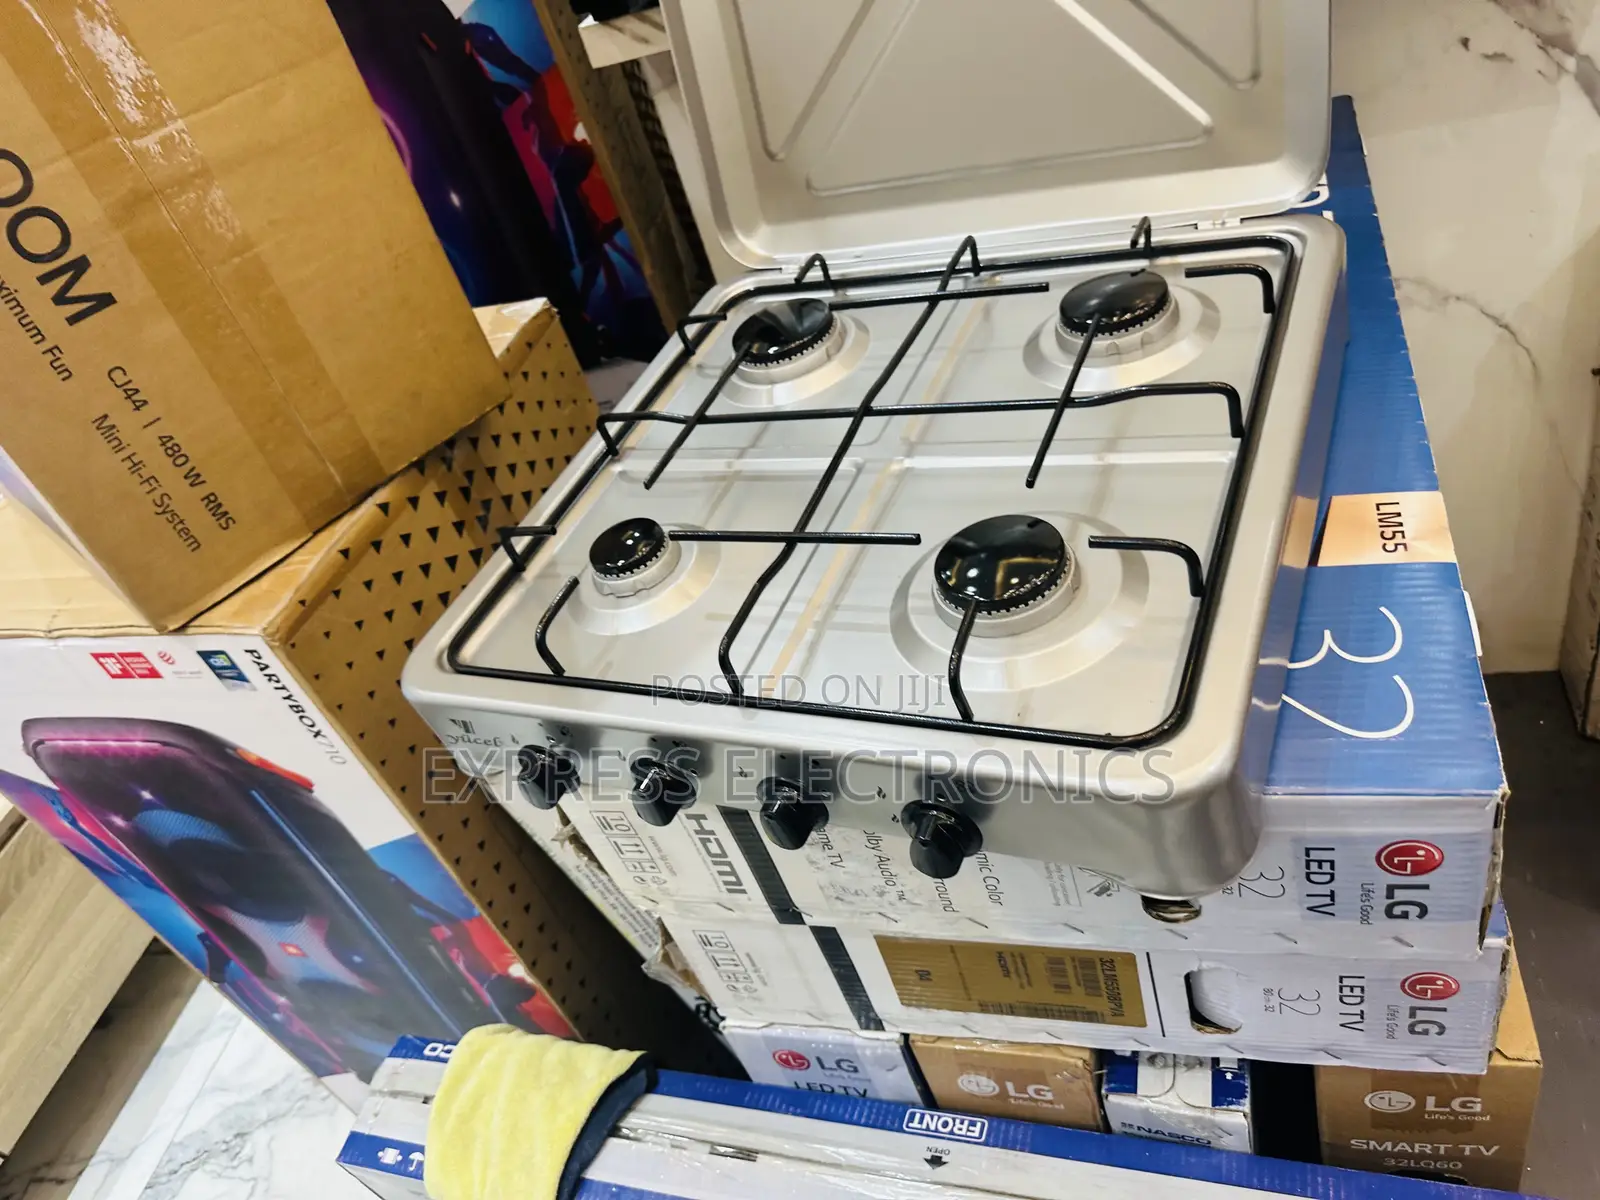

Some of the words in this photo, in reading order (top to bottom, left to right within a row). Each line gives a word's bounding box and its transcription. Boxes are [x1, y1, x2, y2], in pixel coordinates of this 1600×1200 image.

[42, 345, 73, 382] Fun
[107, 366, 149, 412] CJ44
[158, 434, 189, 468] 480
[183, 466, 207, 488] W
[201, 492, 236, 531] RMS
[91, 413, 131, 454] Mini
[121, 452, 161, 494] Hi-Fi
[152, 492, 202, 552] System
[1375, 502, 1408, 553] LM55
[1281, 606, 1414, 739] 32
[684, 813, 748, 895] HDMI
[816, 827, 834, 851] ame
[828, 852, 846, 868] TV
[873, 853, 898, 887] Audio
[1304, 846, 1336, 885] LED
[983, 876, 1005, 907] Color
[1238, 865, 1286, 898] 32
[1305, 889, 1336, 917] TV
[1359, 904, 1374, 926] Good
[1384, 883, 1431, 920] LG
[1278, 987, 1321, 1016] 32
[1338, 974, 1365, 1006] LED
[1338, 1009, 1365, 1032] TV
[1407, 1005, 1448, 1037] LG
[815, 1055, 860, 1074] LG
[838, 1084, 868, 1098] TV
[1005, 1080, 1055, 1101] LG
[1424, 1095, 1483, 1113] LG
[907, 1112, 982, 1138] FRONT
[1424, 1112, 1455, 1121] Life's
[1458, 1113, 1492, 1122] Good
[1135, 1125, 1212, 1145] NASCO
[1350, 1138, 1453, 1155] SMART
[1458, 1144, 1500, 1157] TV
[926, 1146, 951, 1156] OPEN
[1383, 1157, 1463, 1170] 32LQ60
